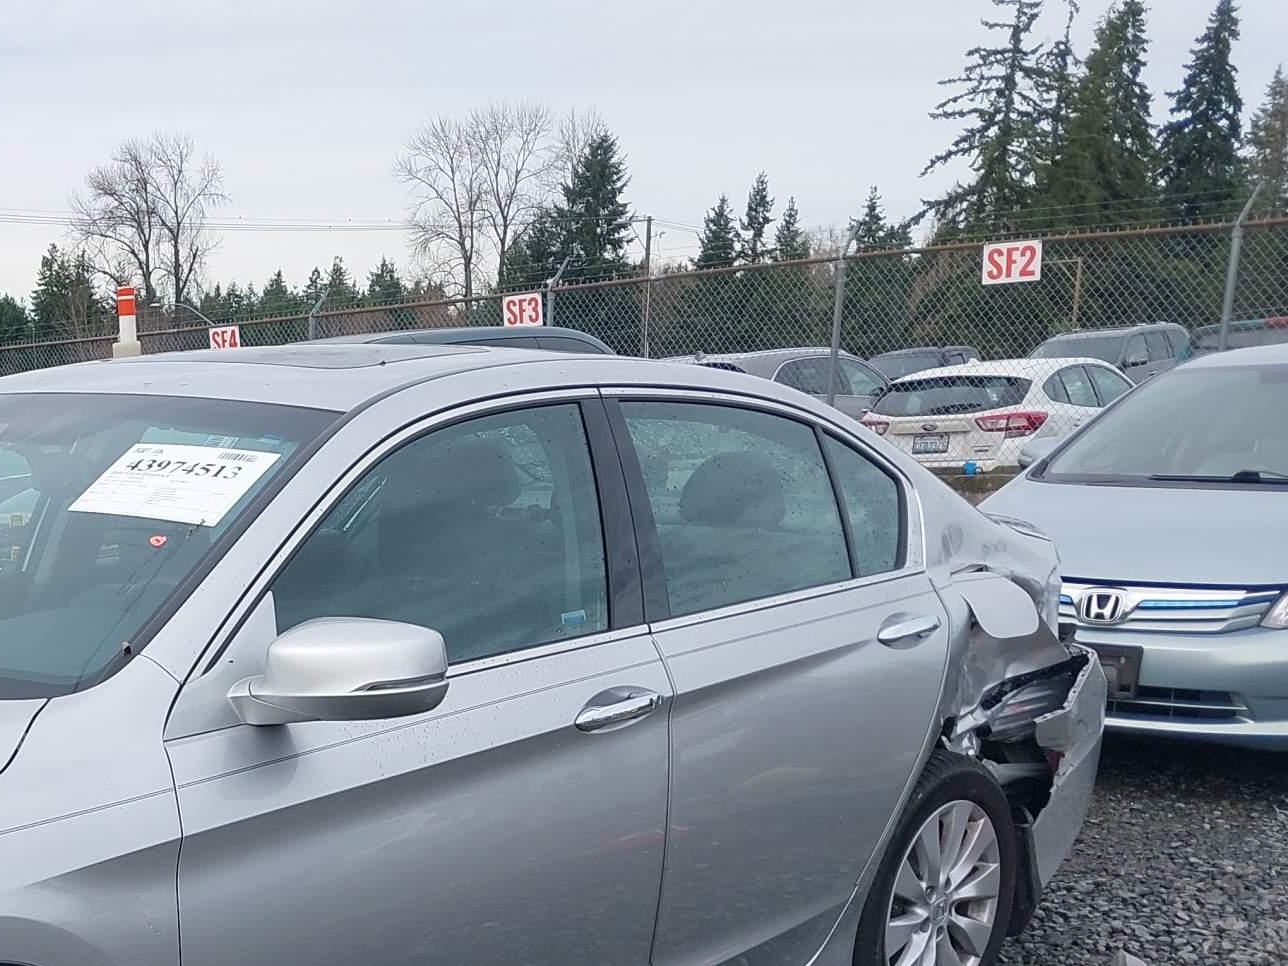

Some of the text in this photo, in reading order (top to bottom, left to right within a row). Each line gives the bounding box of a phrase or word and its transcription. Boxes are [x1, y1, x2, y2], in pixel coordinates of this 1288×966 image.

[986, 245, 1037, 280] SF2
[506, 296, 540, 325] SF3
[212, 329, 238, 348] SF4
[125, 458, 243, 480] 43974513
